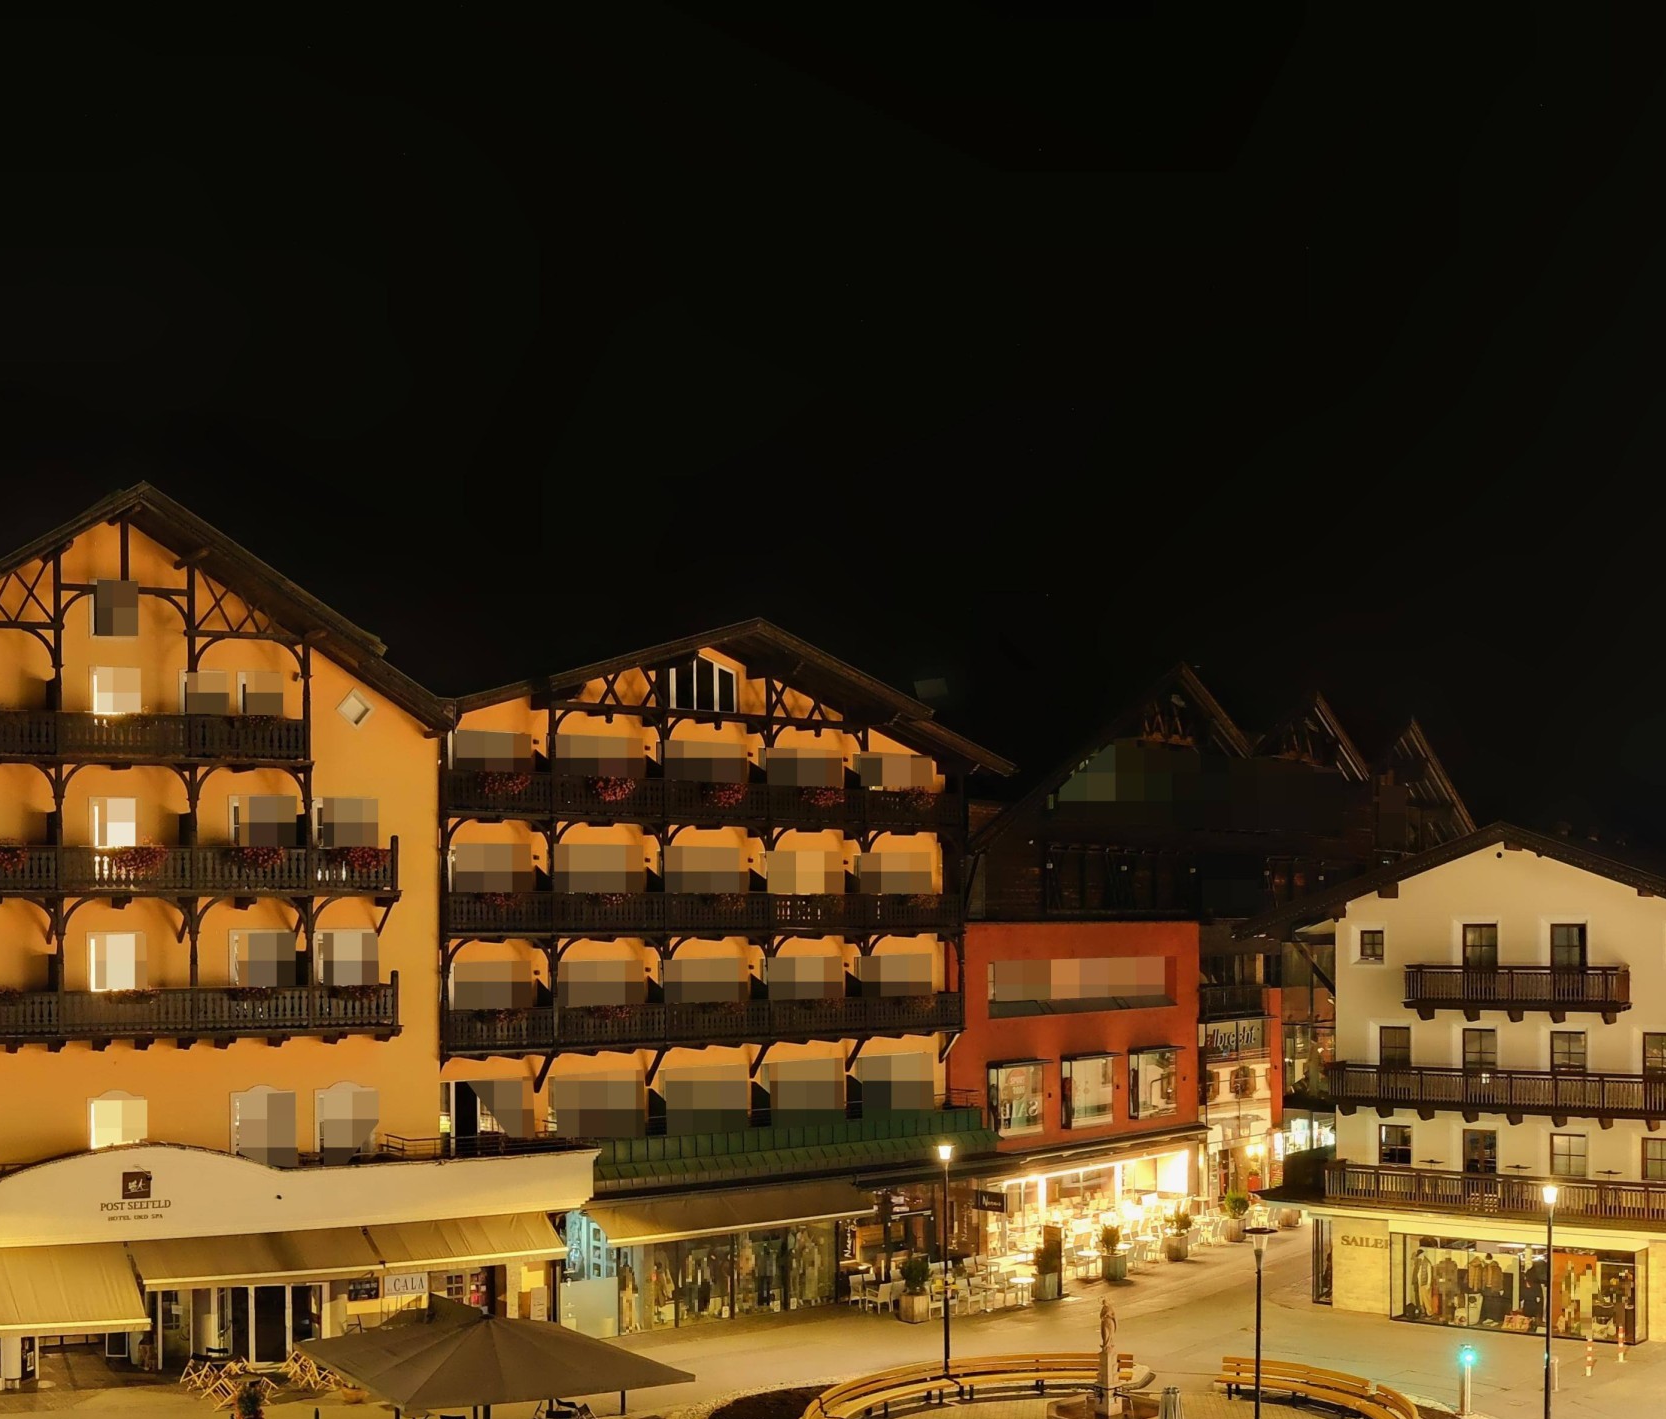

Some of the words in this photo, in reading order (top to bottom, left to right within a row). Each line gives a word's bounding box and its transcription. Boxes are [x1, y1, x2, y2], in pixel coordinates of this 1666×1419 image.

[100, 1202, 126, 1211] POST
[128, 1200, 171, 1211] SEEFELD
[393, 1276, 424, 1292] CALA
